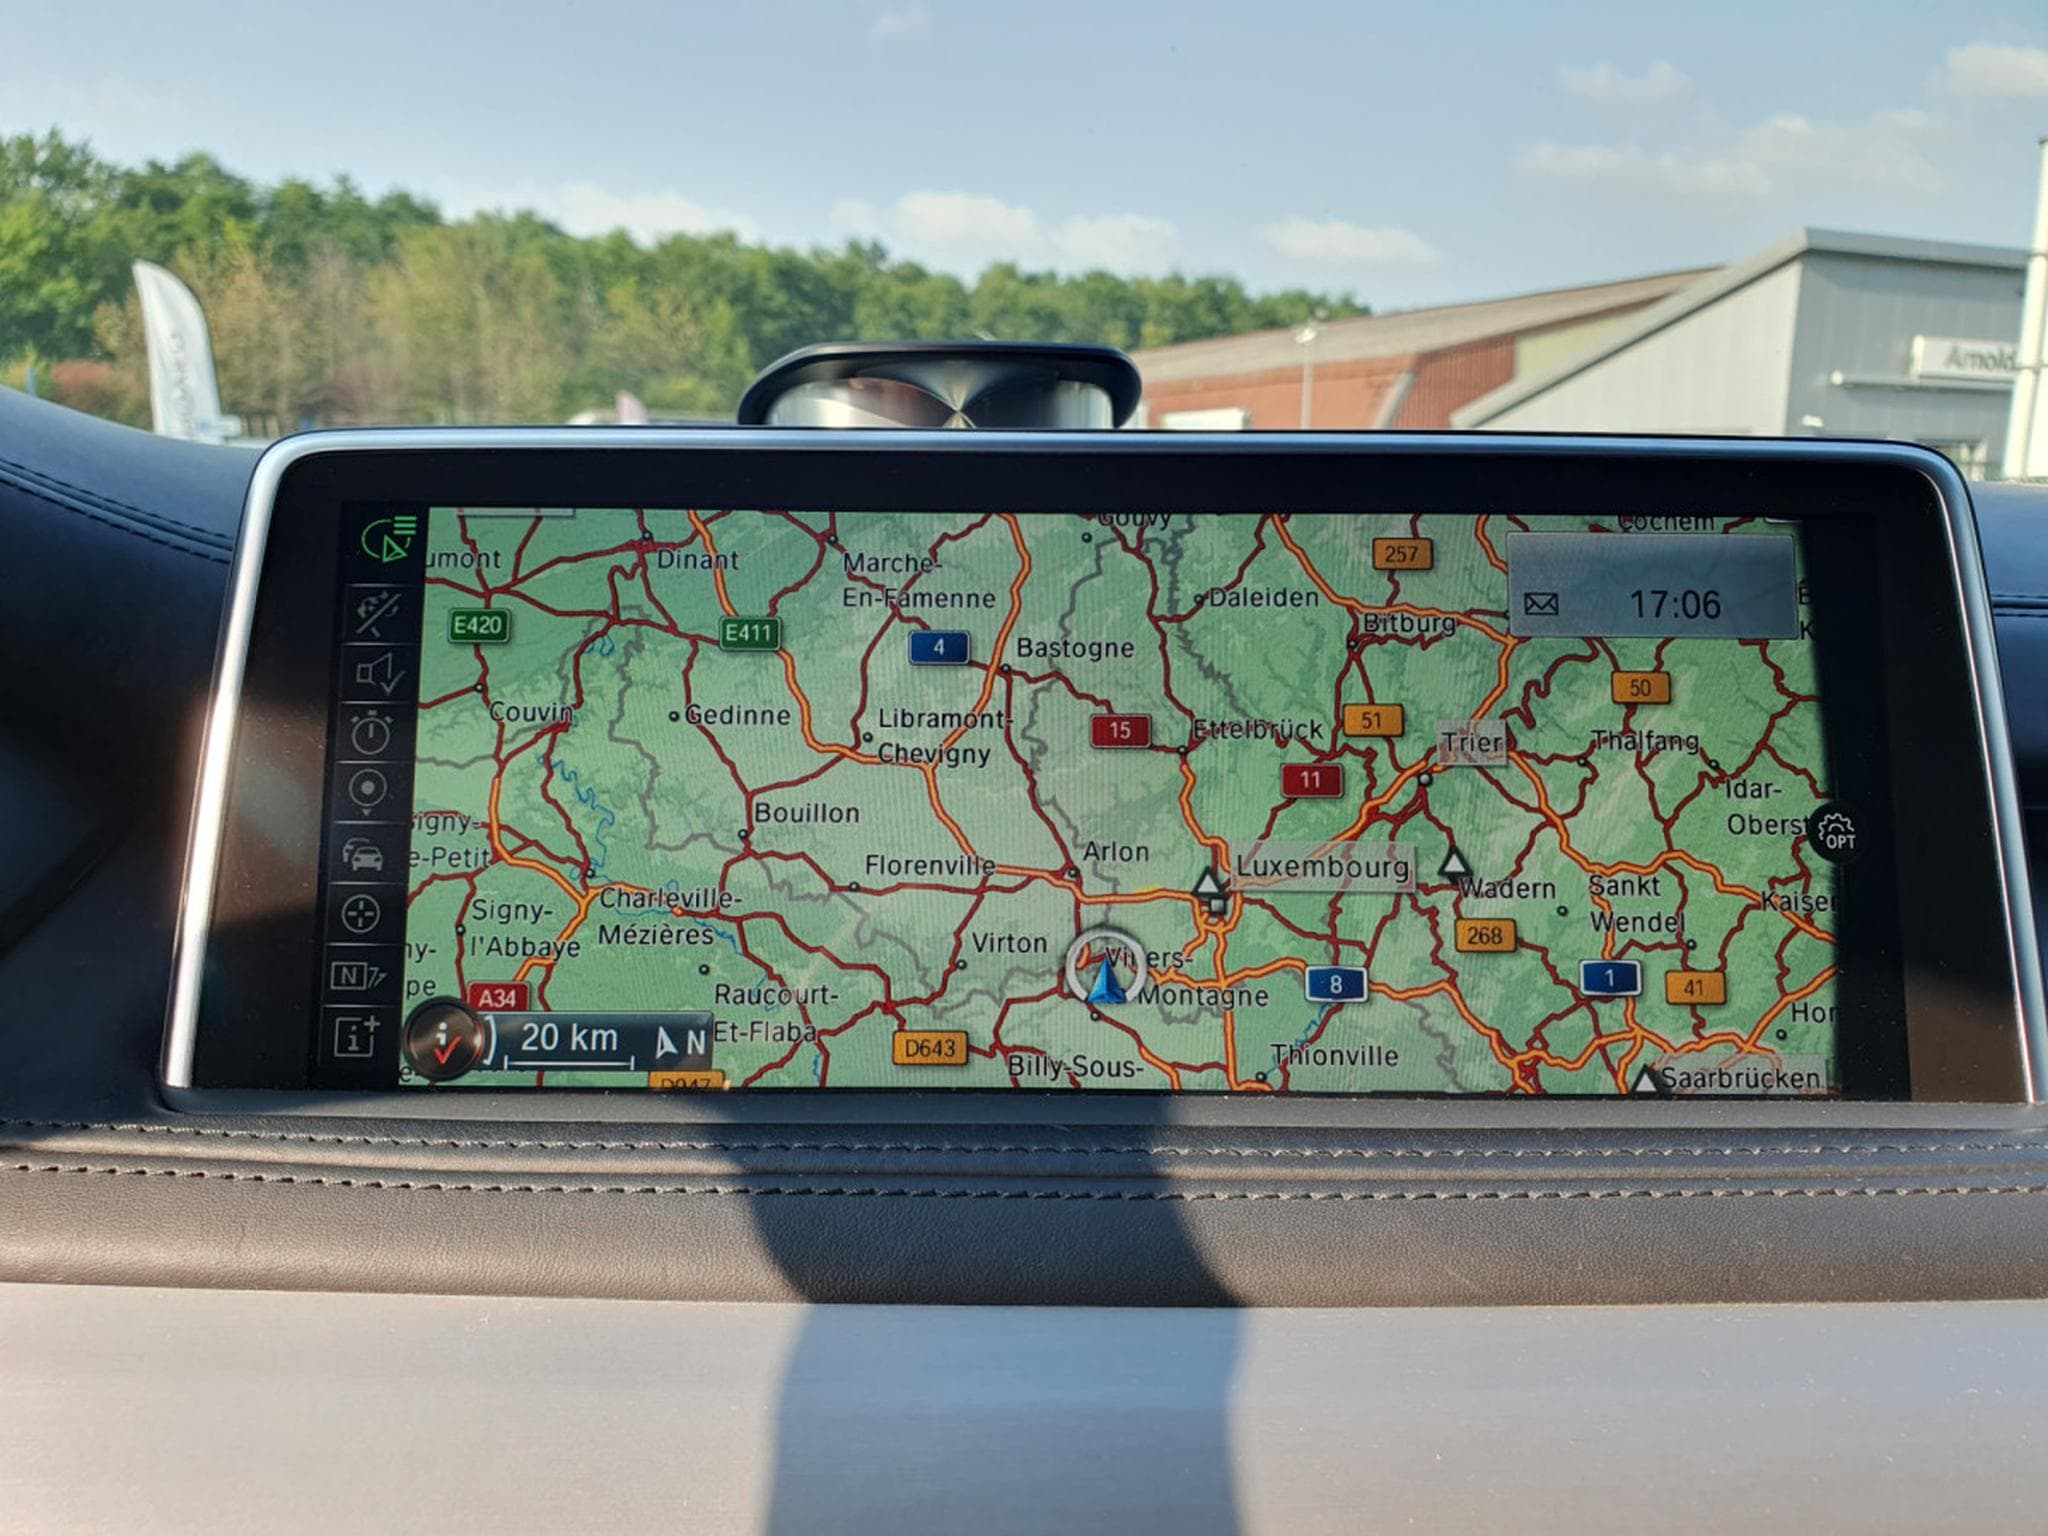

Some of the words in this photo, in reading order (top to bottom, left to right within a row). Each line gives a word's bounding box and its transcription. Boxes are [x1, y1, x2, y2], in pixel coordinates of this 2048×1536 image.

[657, 550, 739, 570] Dinant
[843, 553, 943, 573] Marche-
[1385, 545, 1418, 563] 257
[843, 588, 996, 608] En-Famenne
[1210, 587, 1319, 607] Daleiden
[1631, 590, 1721, 619] 17:06
[454, 616, 501, 634] E420
[726, 624, 770, 641] E411
[1363, 613, 1456, 636] Bitburg
[933, 639, 944, 655] 4
[1017, 637, 1135, 661] Bastogne
[1630, 680, 1651, 697] 50
[489, 701, 573, 722] Couvin
[685, 703, 791, 725] Gedinne
[879, 708, 1014, 729] Libramont-
[1361, 714, 1382, 729] 51
[1109, 722, 1131, 739] 15
[1193, 719, 1324, 740] Ettelbrück
[1442, 732, 1503, 753] Trier
[1592, 730, 1700, 755] Thalfang
[878, 742, 991, 768] Chevigny
[1300, 771, 1320, 788] 11
[1726, 779, 1782, 799] Idar-
[755, 803, 860, 823] Bouillon
[411, 813, 482, 836] igny-
[1083, 841, 1149, 861] Arlon
[1826, 834, 1856, 849] OPT
[865, 854, 996, 876] Florenville
[1237, 855, 1410, 883] Luxembourg
[1458, 878, 1556, 899] Wadern
[1589, 874, 1661, 896] Sankt
[600, 887, 742, 909] Charleville-
[472, 899, 553, 924] Signy-
[1591, 912, 1686, 933] Wendel
[598, 924, 714, 945] Mézières
[972, 933, 1047, 953] Virton
[1467, 928, 1503, 944] 268
[471, 937, 581, 961] l'Abbaye
[1105, 947, 1194, 969] Vilers-
[1330, 975, 1342, 994] 8
[1605, 969, 1614, 987] 1
[1684, 980, 1704, 997] 41
[479, 990, 516, 1008] A34
[715, 984, 839, 1004] Raucourt-
[1139, 986, 1269, 1010] Montagne
[522, 1024, 559, 1050] 20
[571, 1024, 618, 1050] km
[687, 1030, 705, 1055] N
[714, 1022, 816, 1042] Et-Flaba
[906, 1040, 955, 1057] D643
[1271, 1044, 1399, 1067] Thionville
[1009, 1055, 1144, 1081] Billy-Sous-
[1660, 1066, 1821, 1089] Saarbrücken
